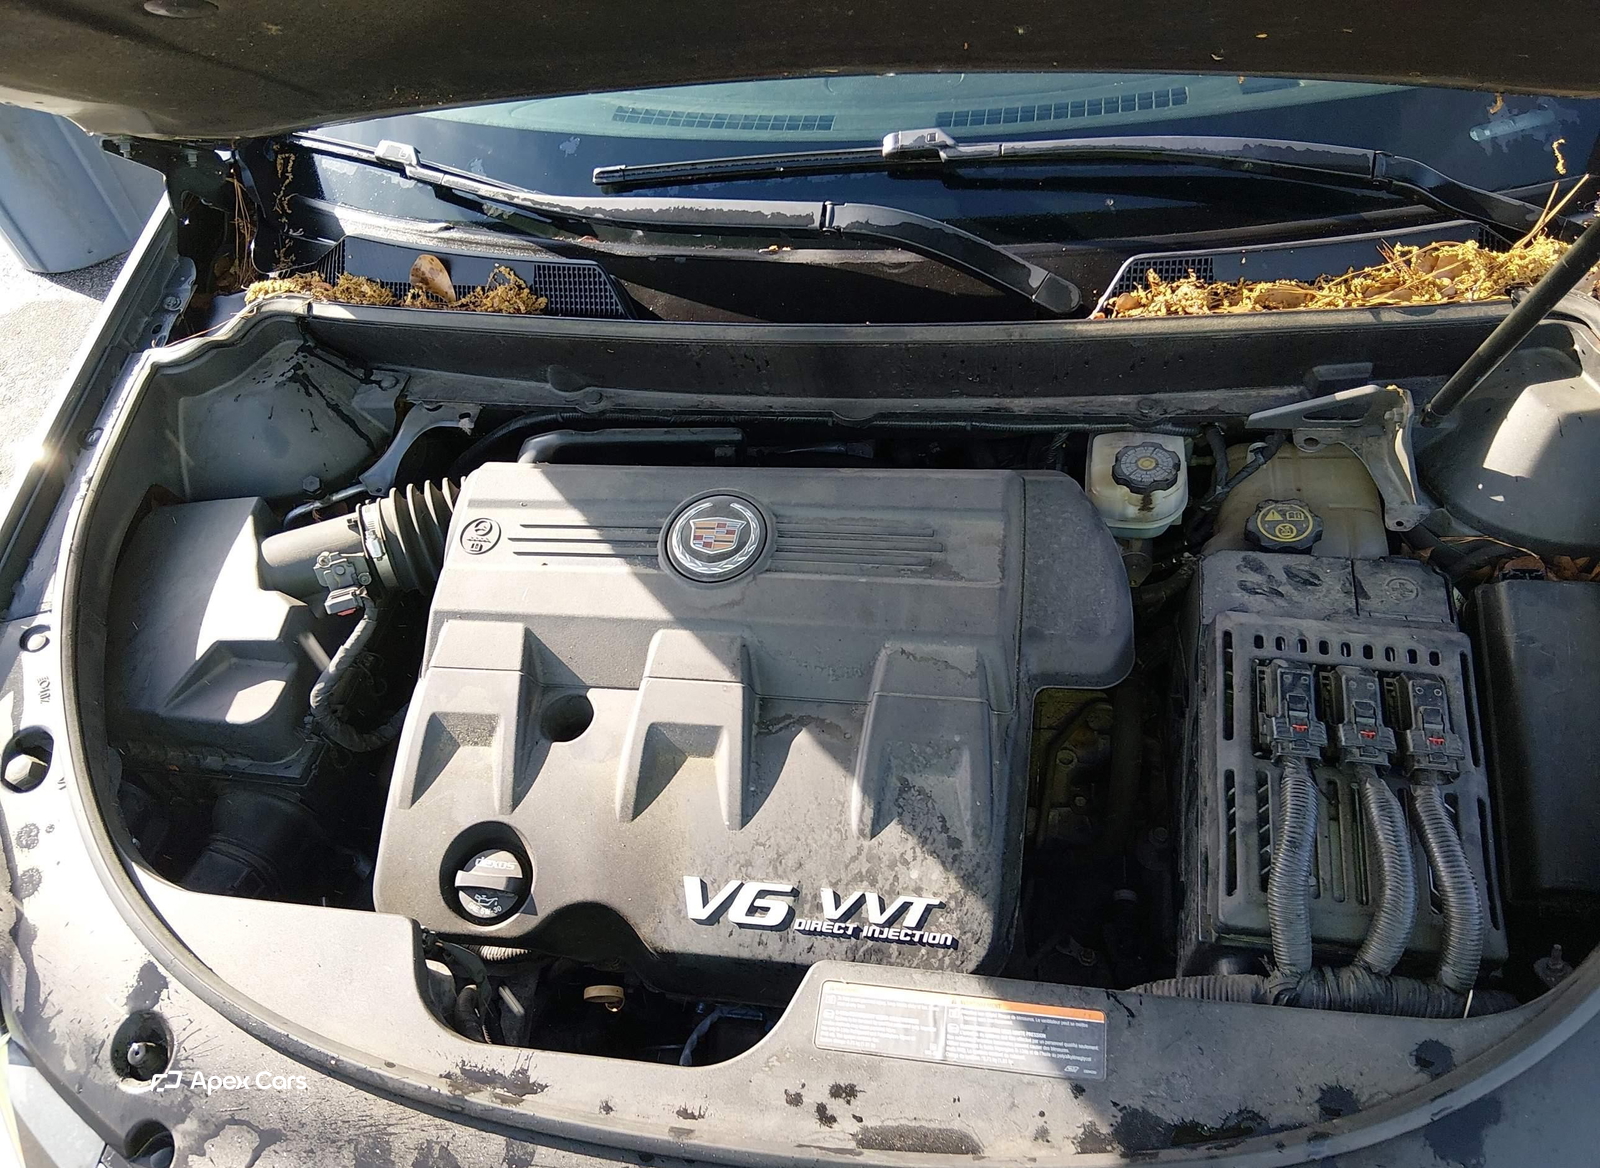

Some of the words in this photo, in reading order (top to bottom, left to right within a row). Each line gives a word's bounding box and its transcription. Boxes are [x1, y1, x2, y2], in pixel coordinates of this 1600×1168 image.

[475, 857, 516, 870] dexos
[683, 876, 798, 929] V6
[820, 888, 944, 929] VVT
[794, 918, 860, 937] DIRECT
[862, 926, 956, 947] INJECTION
